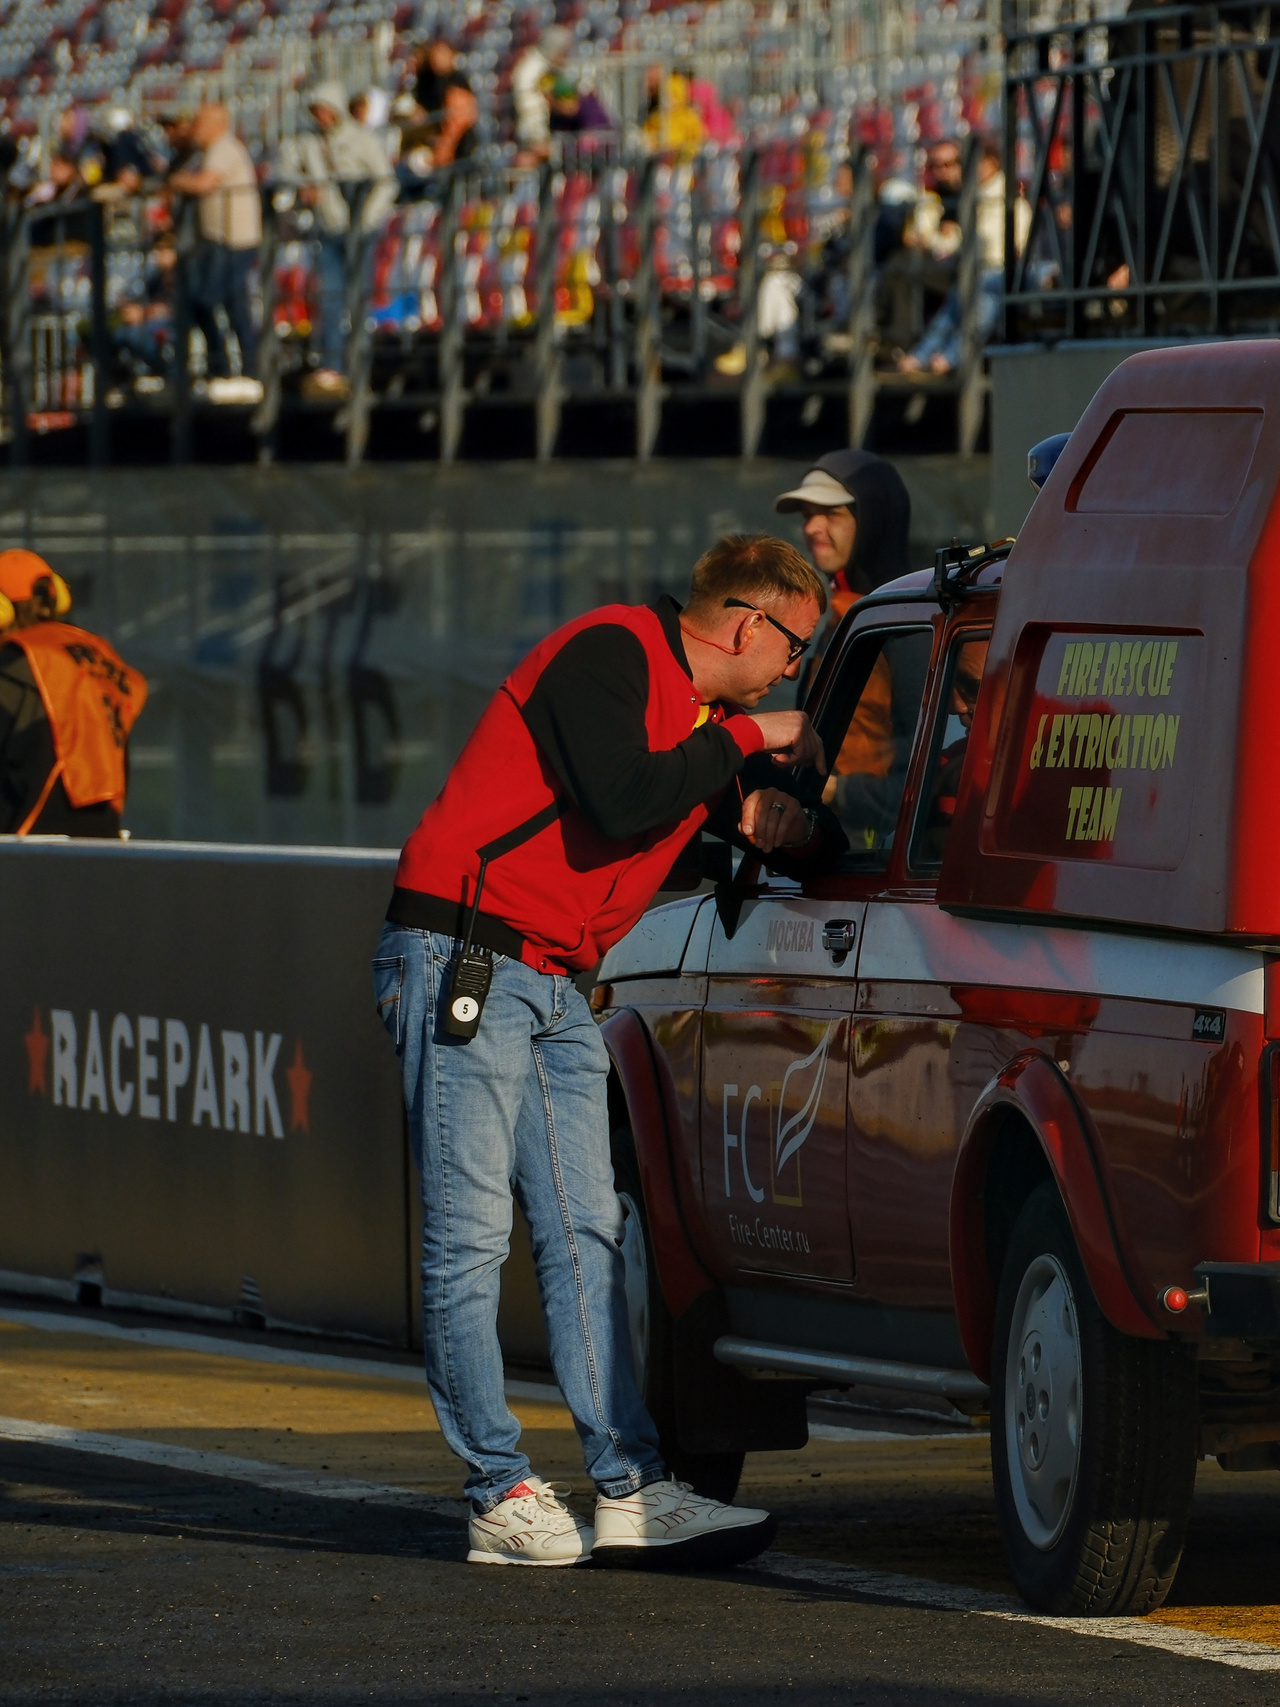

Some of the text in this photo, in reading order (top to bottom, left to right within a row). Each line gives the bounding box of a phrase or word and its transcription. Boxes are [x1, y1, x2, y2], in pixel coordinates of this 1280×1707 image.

[1056, 641, 1178, 697] FIRE RESCUE
[1029, 713, 1181, 771] & EXTRICATION
[1065, 786, 1123, 841] TEAM
[766, 919, 815, 952] МОСКВА
[462, 1004, 468, 1014] 5
[51, 1008, 285, 1140] RACEPARK
[723, 1083, 765, 1203] FC
[728, 1213, 811, 1254] Fire-Center.ru
